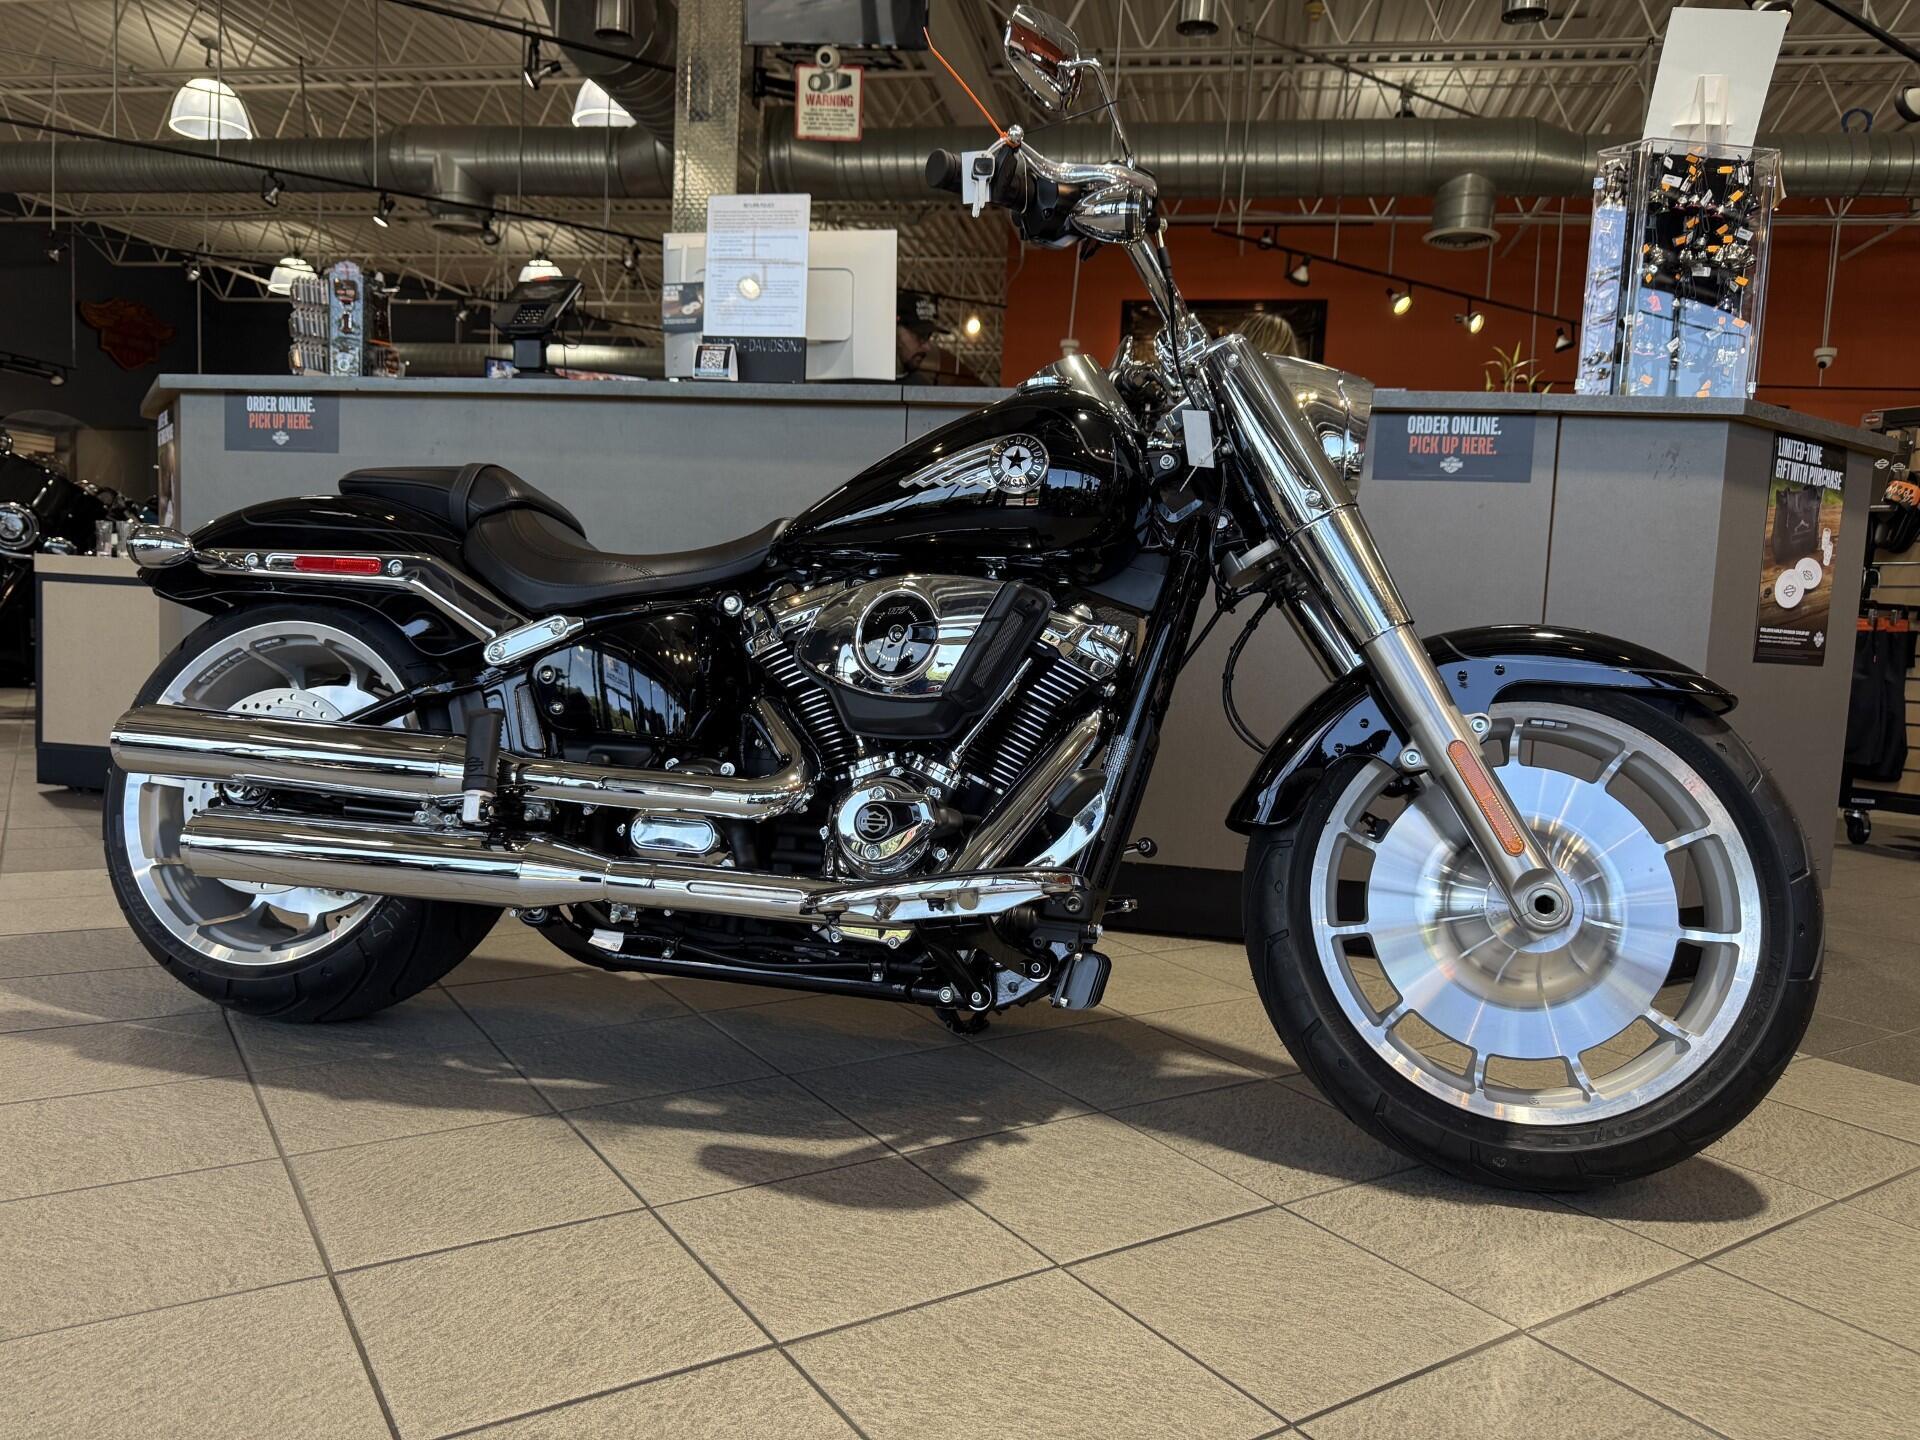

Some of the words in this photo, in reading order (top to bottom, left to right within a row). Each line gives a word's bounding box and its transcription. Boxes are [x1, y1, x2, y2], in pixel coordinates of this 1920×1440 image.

[804, 93, 854, 107] WARNING
[246, 395, 277, 412] ORDER
[278, 396, 315, 413] ONLINE.
[248, 413, 271, 429] PICK
[272, 413, 285, 429] UP
[287, 414, 313, 430] HERE.
[1407, 415, 1449, 434] ORDER
[1451, 416, 1502, 435] ONLINE.
[1408, 435, 1439, 454] PICK
[1441, 436, 1459, 455] UP
[1461, 436, 1497, 455] HERE.
[1777, 436, 1823, 465] LIMITED-TIME
[1775, 458, 1792, 480] GIFT
[1790, 461, 1809, 484] WITH
[1807, 465, 1844, 491] PURCHASE
